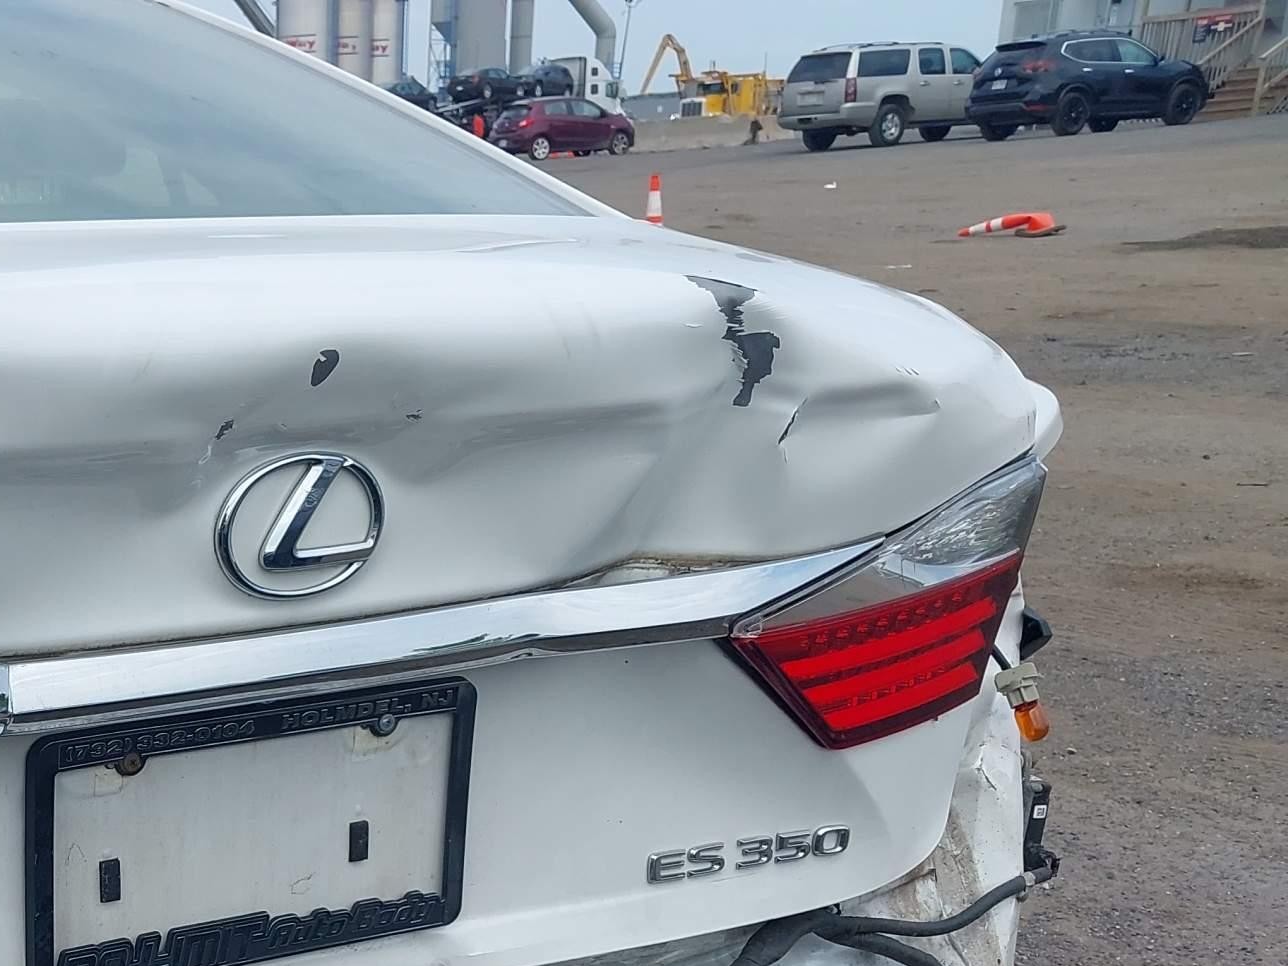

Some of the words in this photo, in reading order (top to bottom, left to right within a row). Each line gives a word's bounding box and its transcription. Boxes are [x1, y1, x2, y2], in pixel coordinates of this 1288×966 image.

[65, 736, 132, 762] (732)
[136, 719, 256, 751] 332-0104
[280, 697, 412, 731] HOLMDEL,
[421, 689, 453, 709] NJ
[647, 841, 726, 884] ES
[735, 823, 851, 870] 350
[268, 911, 350, 949] Auto
